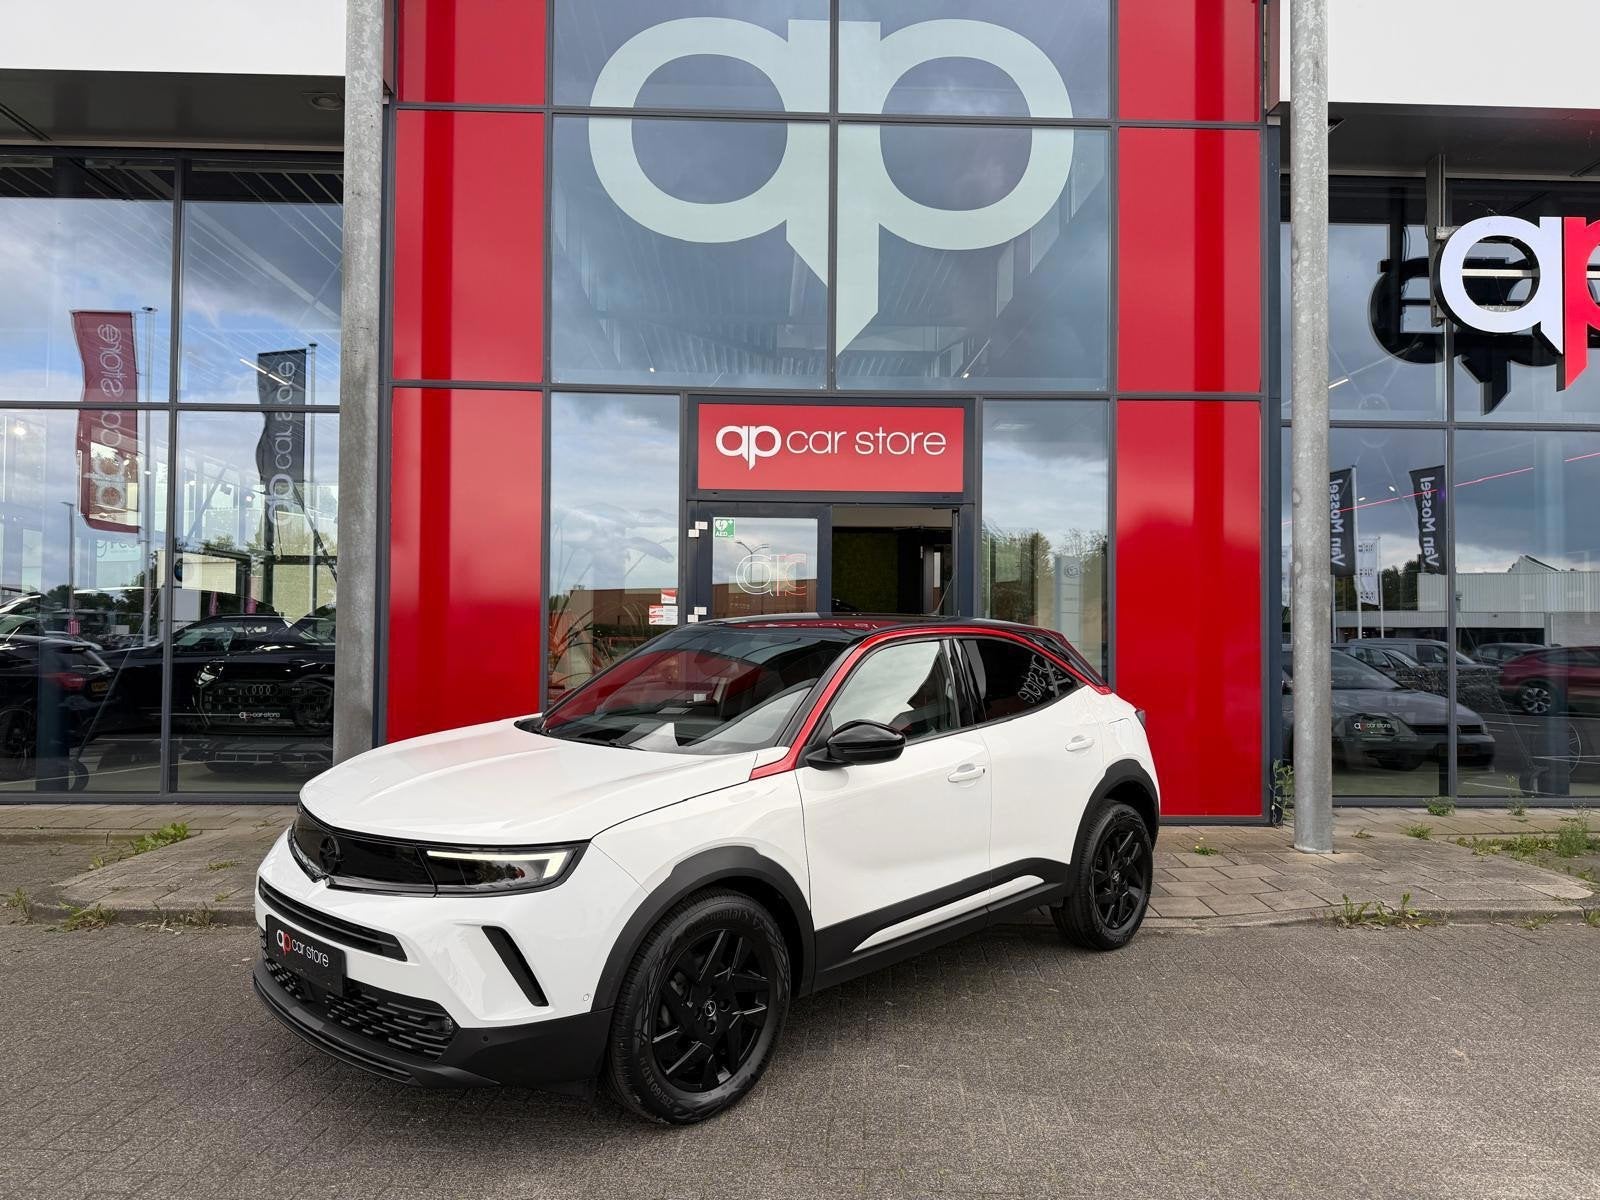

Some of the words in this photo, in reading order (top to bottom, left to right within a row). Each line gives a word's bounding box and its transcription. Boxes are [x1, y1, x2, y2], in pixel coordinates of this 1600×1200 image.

[589, 17, 1074, 356] ap
[716, 425, 782, 471] ap
[786, 430, 847, 454] car
[855, 426, 947, 455] store
[277, 929, 291, 960] ap
[292, 939, 305, 955] car
[306, 945, 329, 967] store
